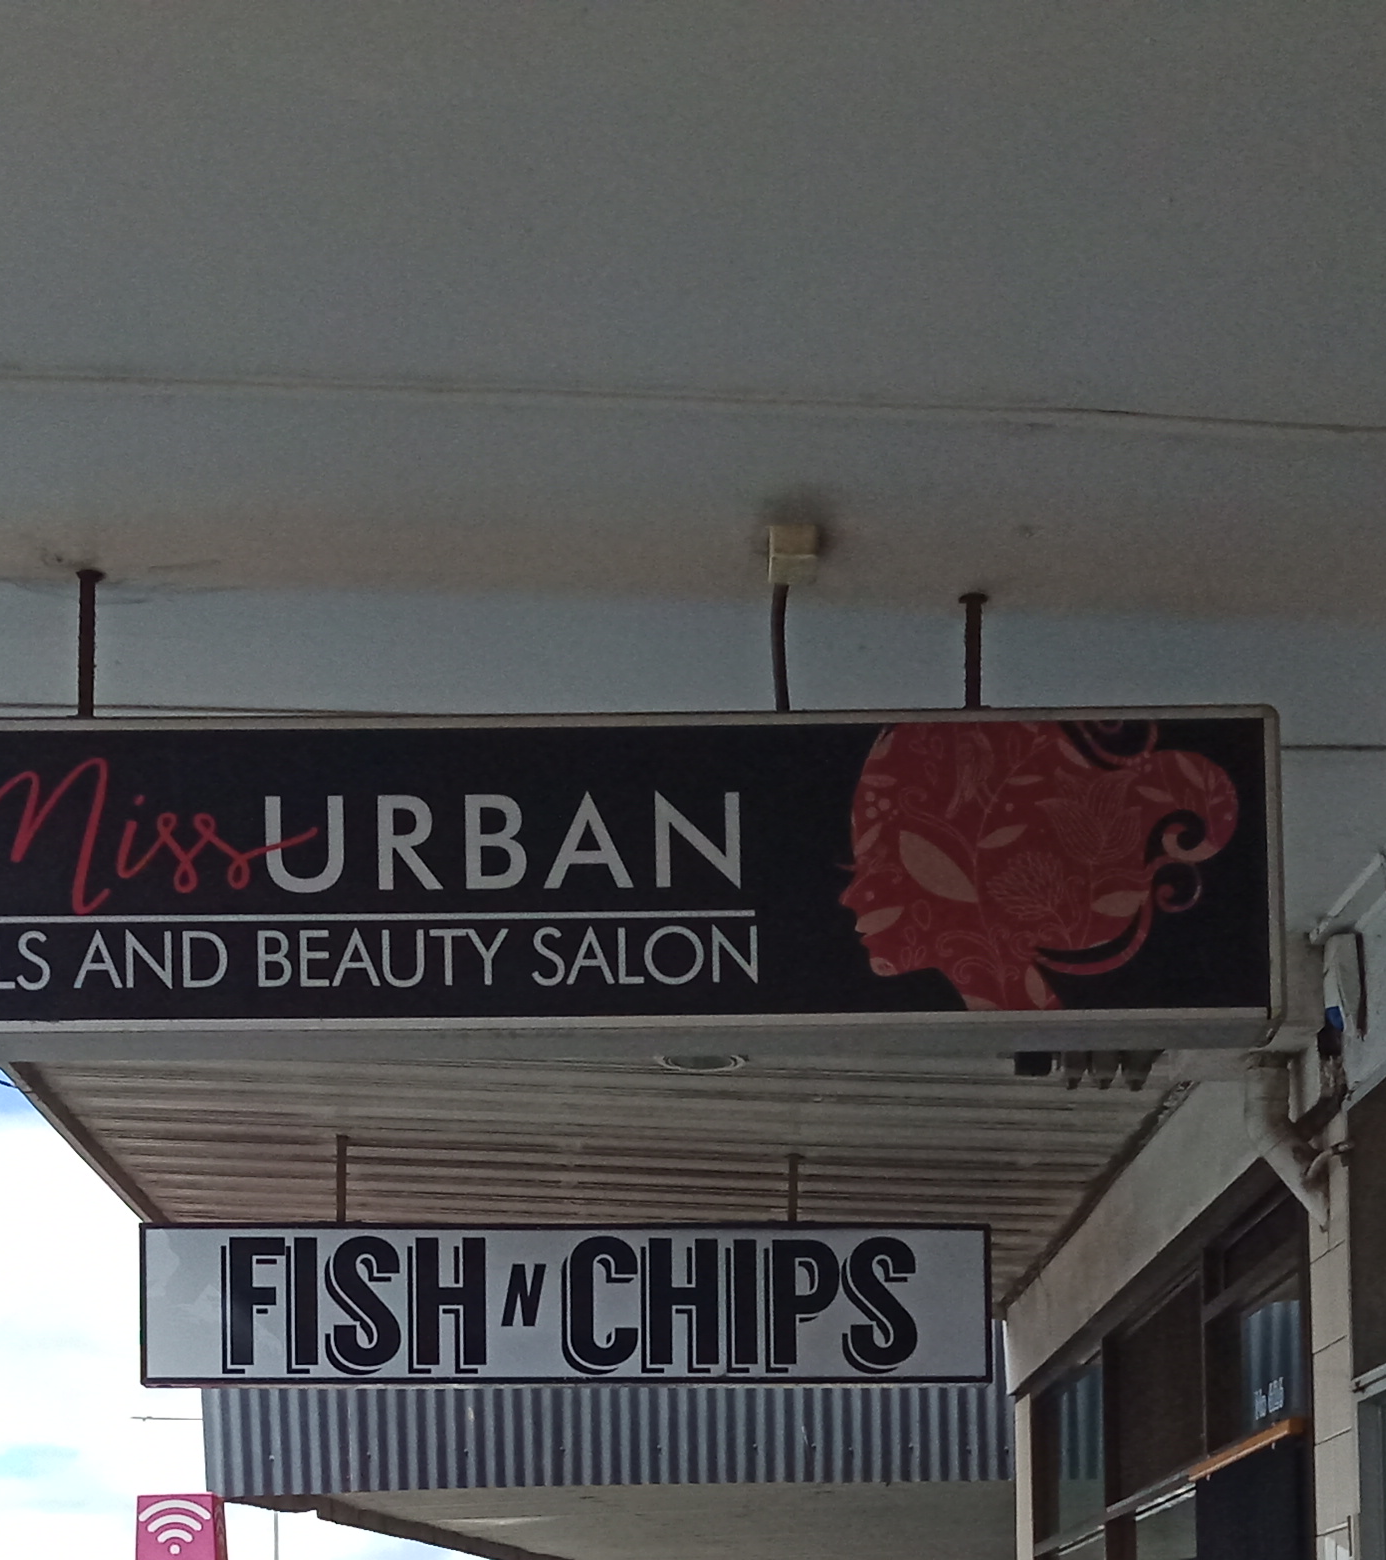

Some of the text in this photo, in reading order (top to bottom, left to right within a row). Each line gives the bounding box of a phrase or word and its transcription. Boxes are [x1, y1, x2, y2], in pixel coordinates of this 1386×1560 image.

[264, 790, 741, 893] URBAN
[73, 928, 228, 990] AND
[257, 926, 509, 988] BEAUTY
[531, 924, 759, 986] SALON
[220, 1235, 919, 1375] FISH N CHIPS
